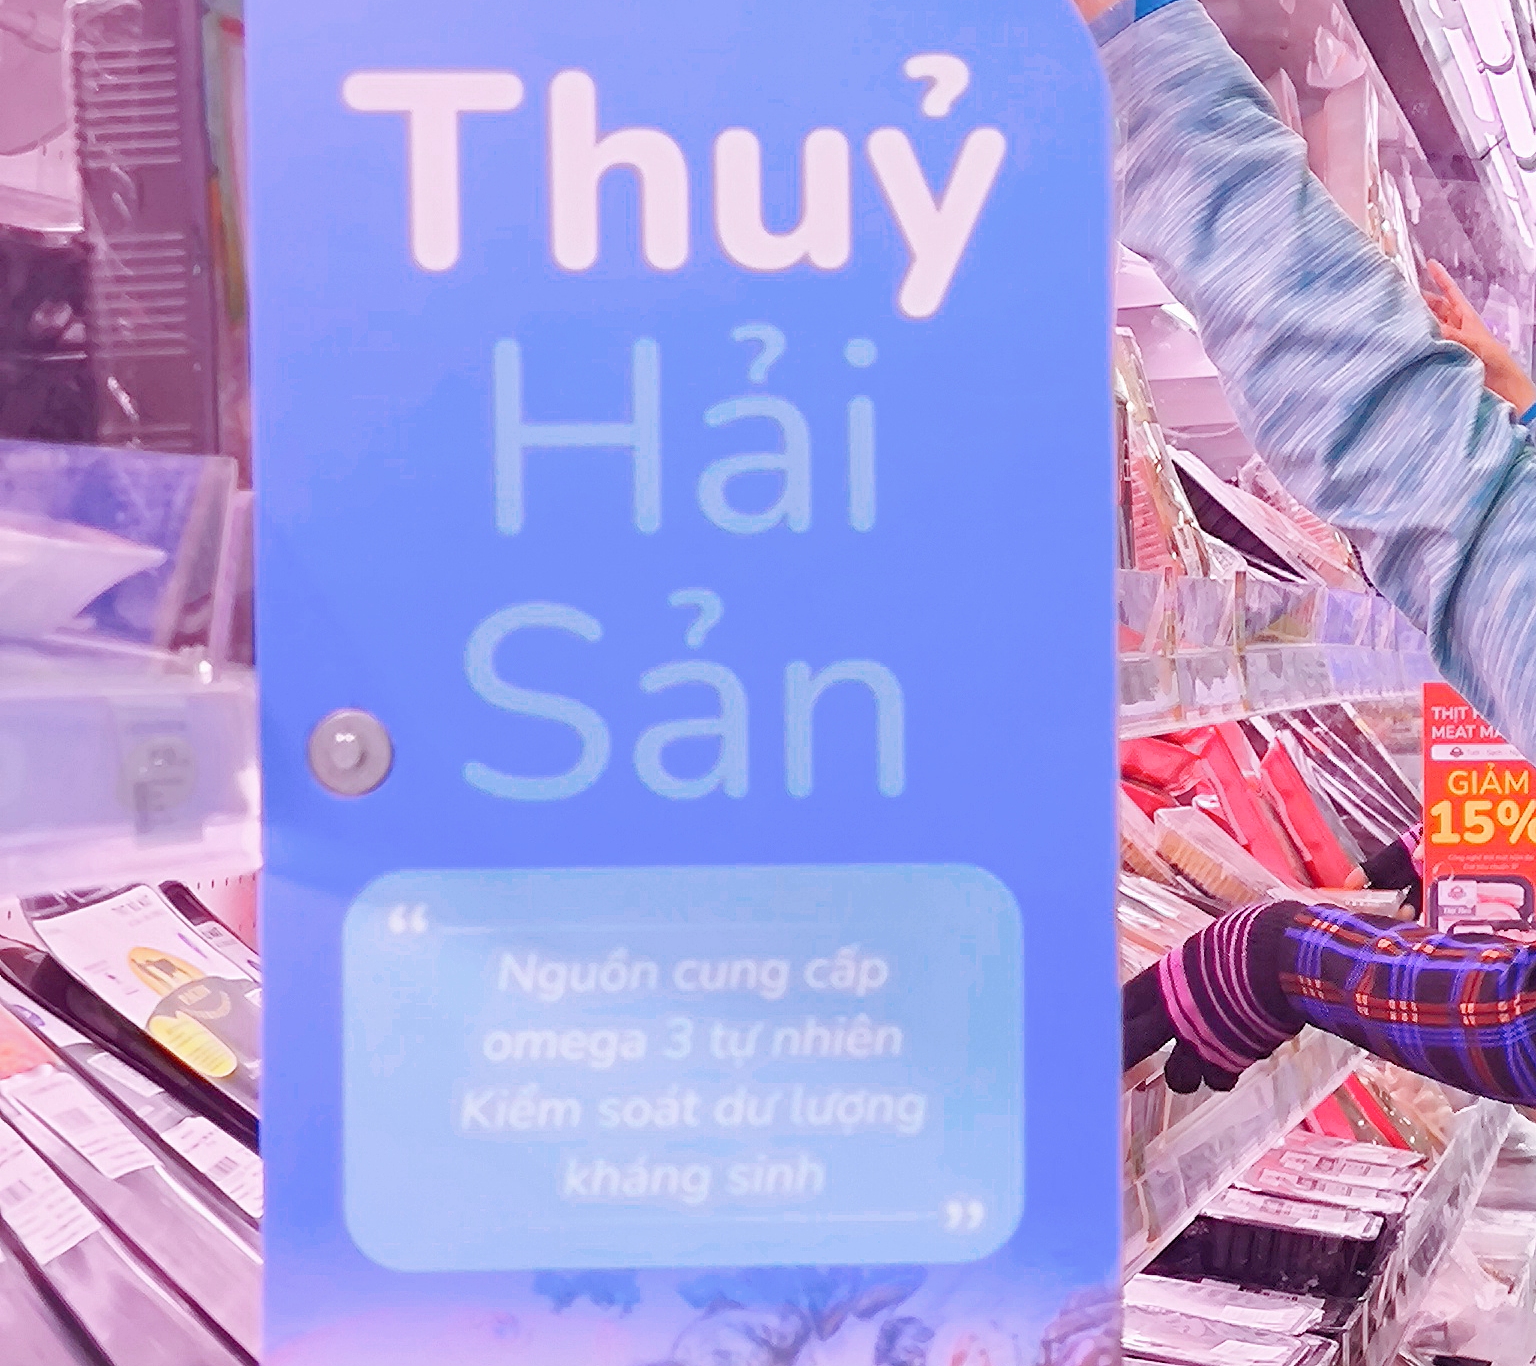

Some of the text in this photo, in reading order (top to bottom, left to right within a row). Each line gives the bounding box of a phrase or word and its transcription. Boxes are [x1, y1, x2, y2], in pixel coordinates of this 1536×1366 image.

[341, 51, 1008, 319] Thuỷ
[491, 323, 879, 535] Hải
[461, 588, 909, 799] Sản
[1430, 705, 1470, 724] THỊT
[1430, 724, 1477, 740] MEAT
[1446, 762, 1530, 796] GIẢM
[672, 953, 791, 1000] cung
[482, 1012, 904, 1070] omega 3 tự nhiên
[597, 1082, 703, 1130] soát
[712, 1084, 785, 1128] dư
[790, 1082, 928, 1135] lượng
[562, 1152, 828, 1205] kháng sinh
